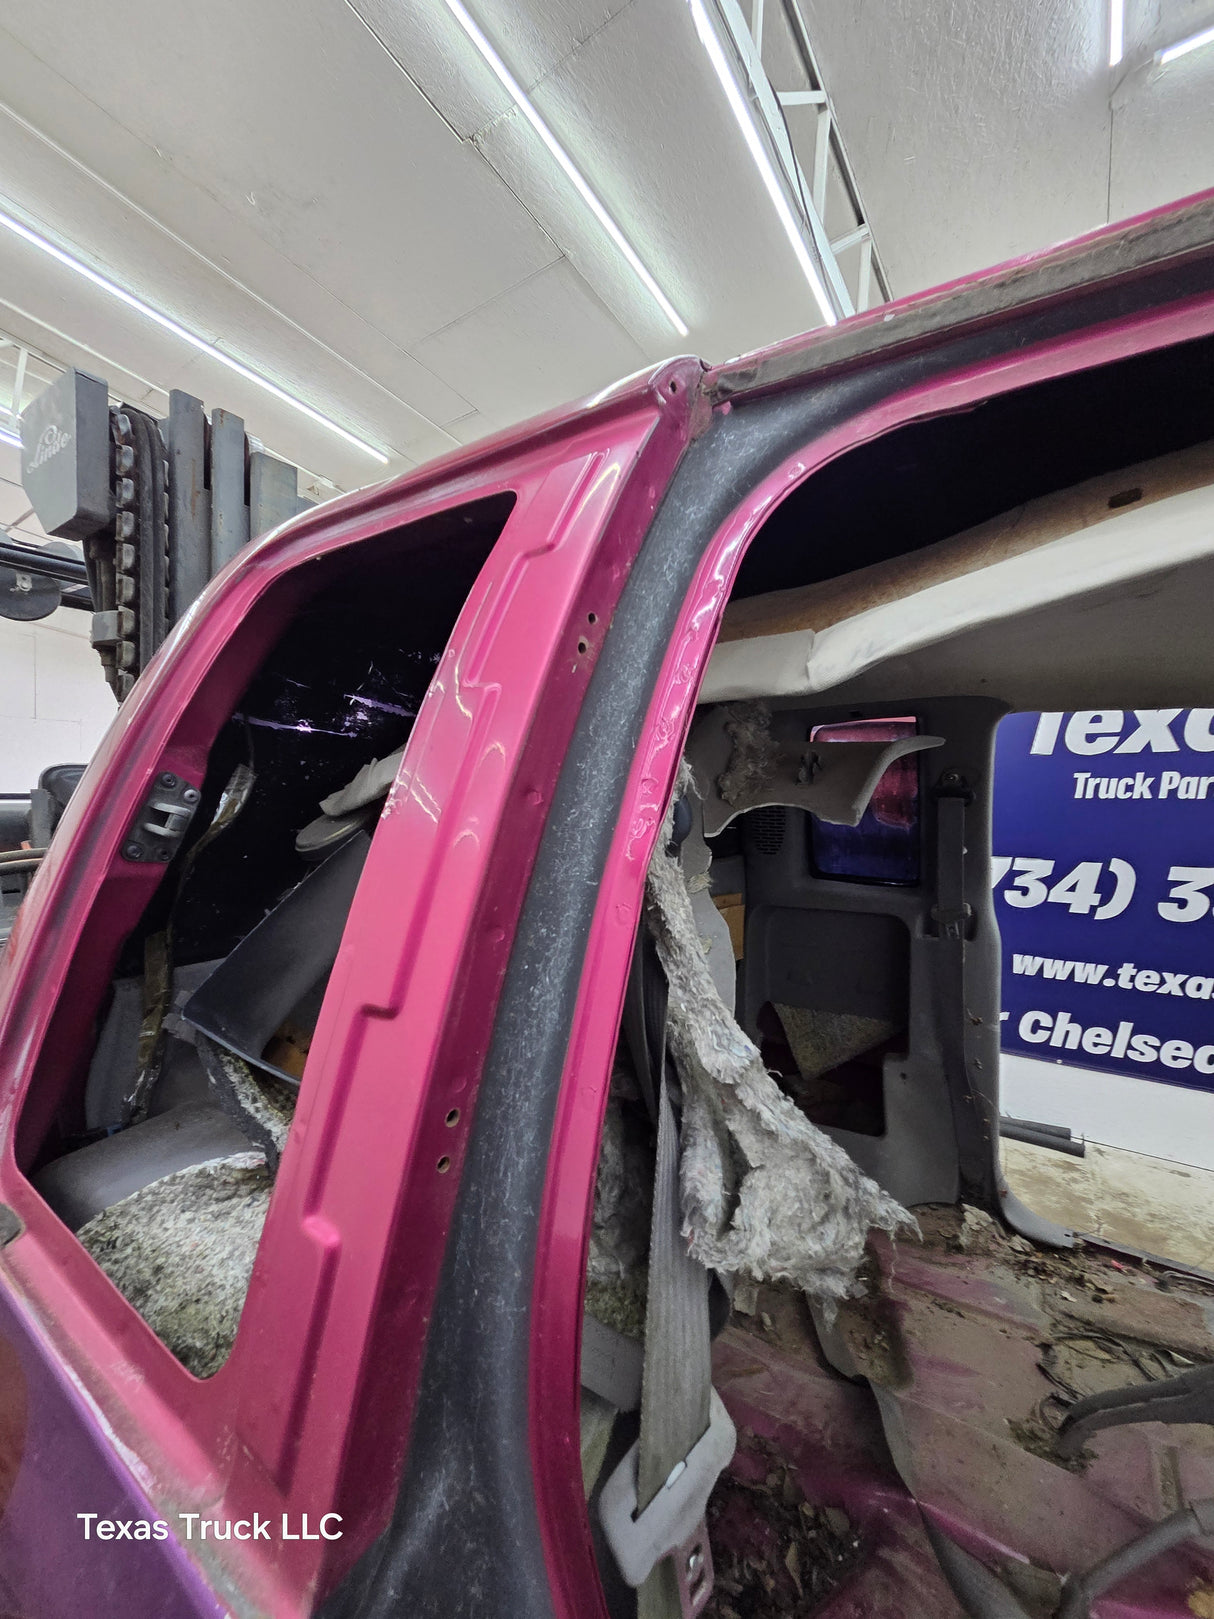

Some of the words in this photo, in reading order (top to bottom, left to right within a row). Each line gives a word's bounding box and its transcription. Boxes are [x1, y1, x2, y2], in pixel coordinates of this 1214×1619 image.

[1073, 771, 1155, 799] Truck
[1157, 866, 1214, 923] 3
[1012, 953, 1214, 1000] www.texa
